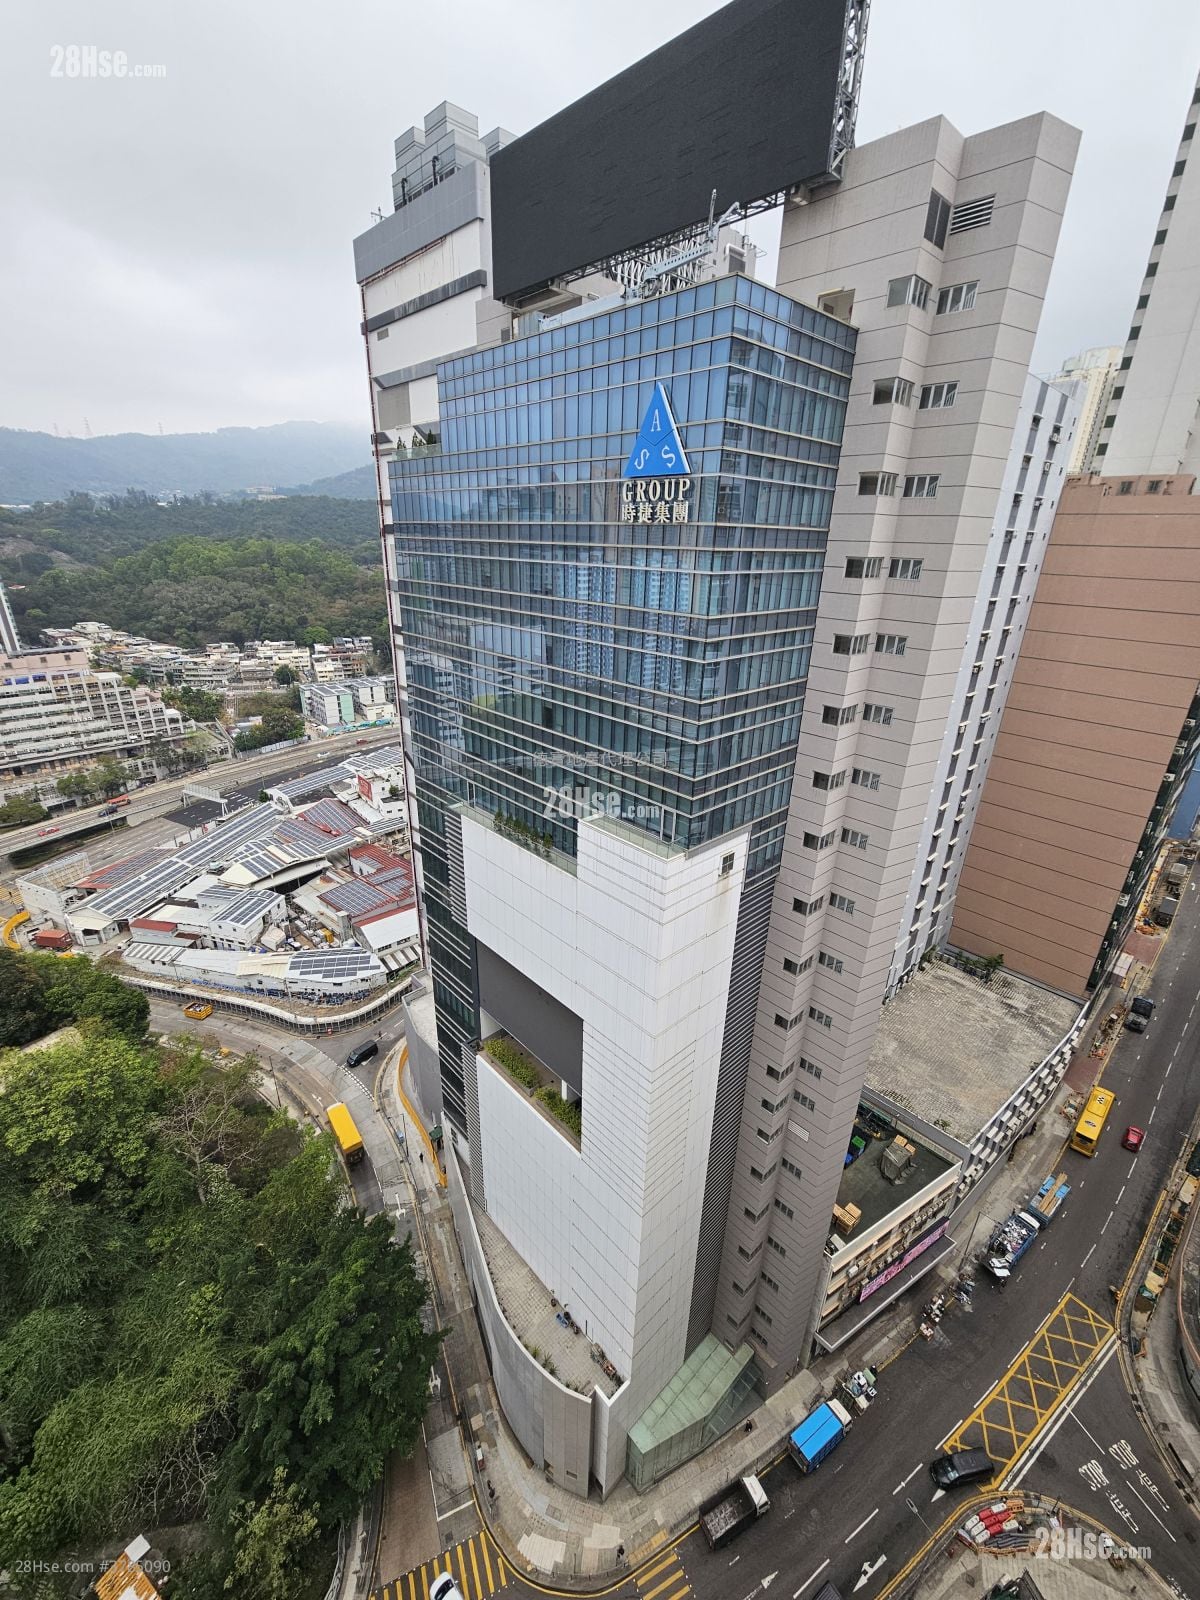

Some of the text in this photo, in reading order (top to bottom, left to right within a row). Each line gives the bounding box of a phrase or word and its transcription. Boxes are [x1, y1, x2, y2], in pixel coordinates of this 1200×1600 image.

[650, 408, 662, 432] A
[622, 478, 691, 502] GROUP
[621, 501, 689, 524] 時捷集團
[1108, 1439, 1140, 1470] STOP
[1078, 1459, 1110, 1491] STOP
